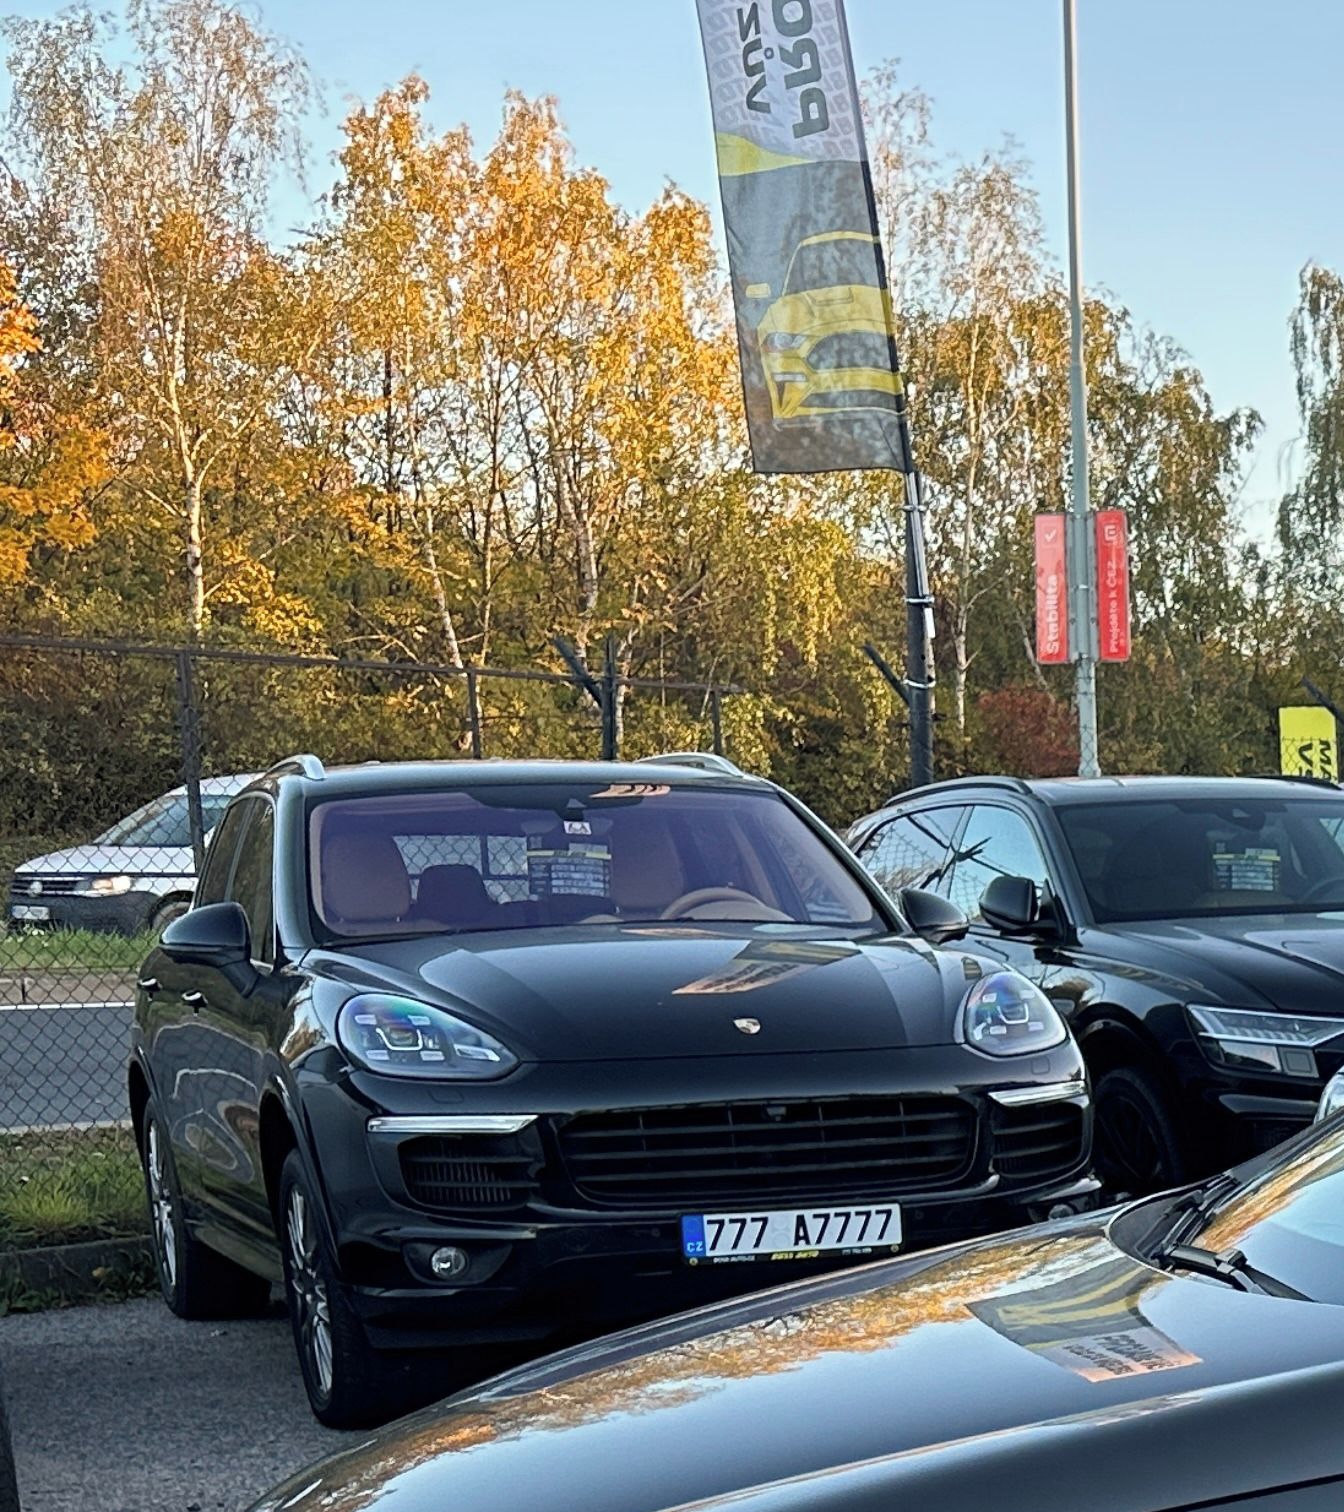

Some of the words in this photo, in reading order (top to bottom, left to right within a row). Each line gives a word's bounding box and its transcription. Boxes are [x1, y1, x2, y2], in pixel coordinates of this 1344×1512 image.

[686, 1241, 704, 1253] CZ
[706, 1216, 769, 1251] 777
[793, 1208, 893, 1247] A7777
